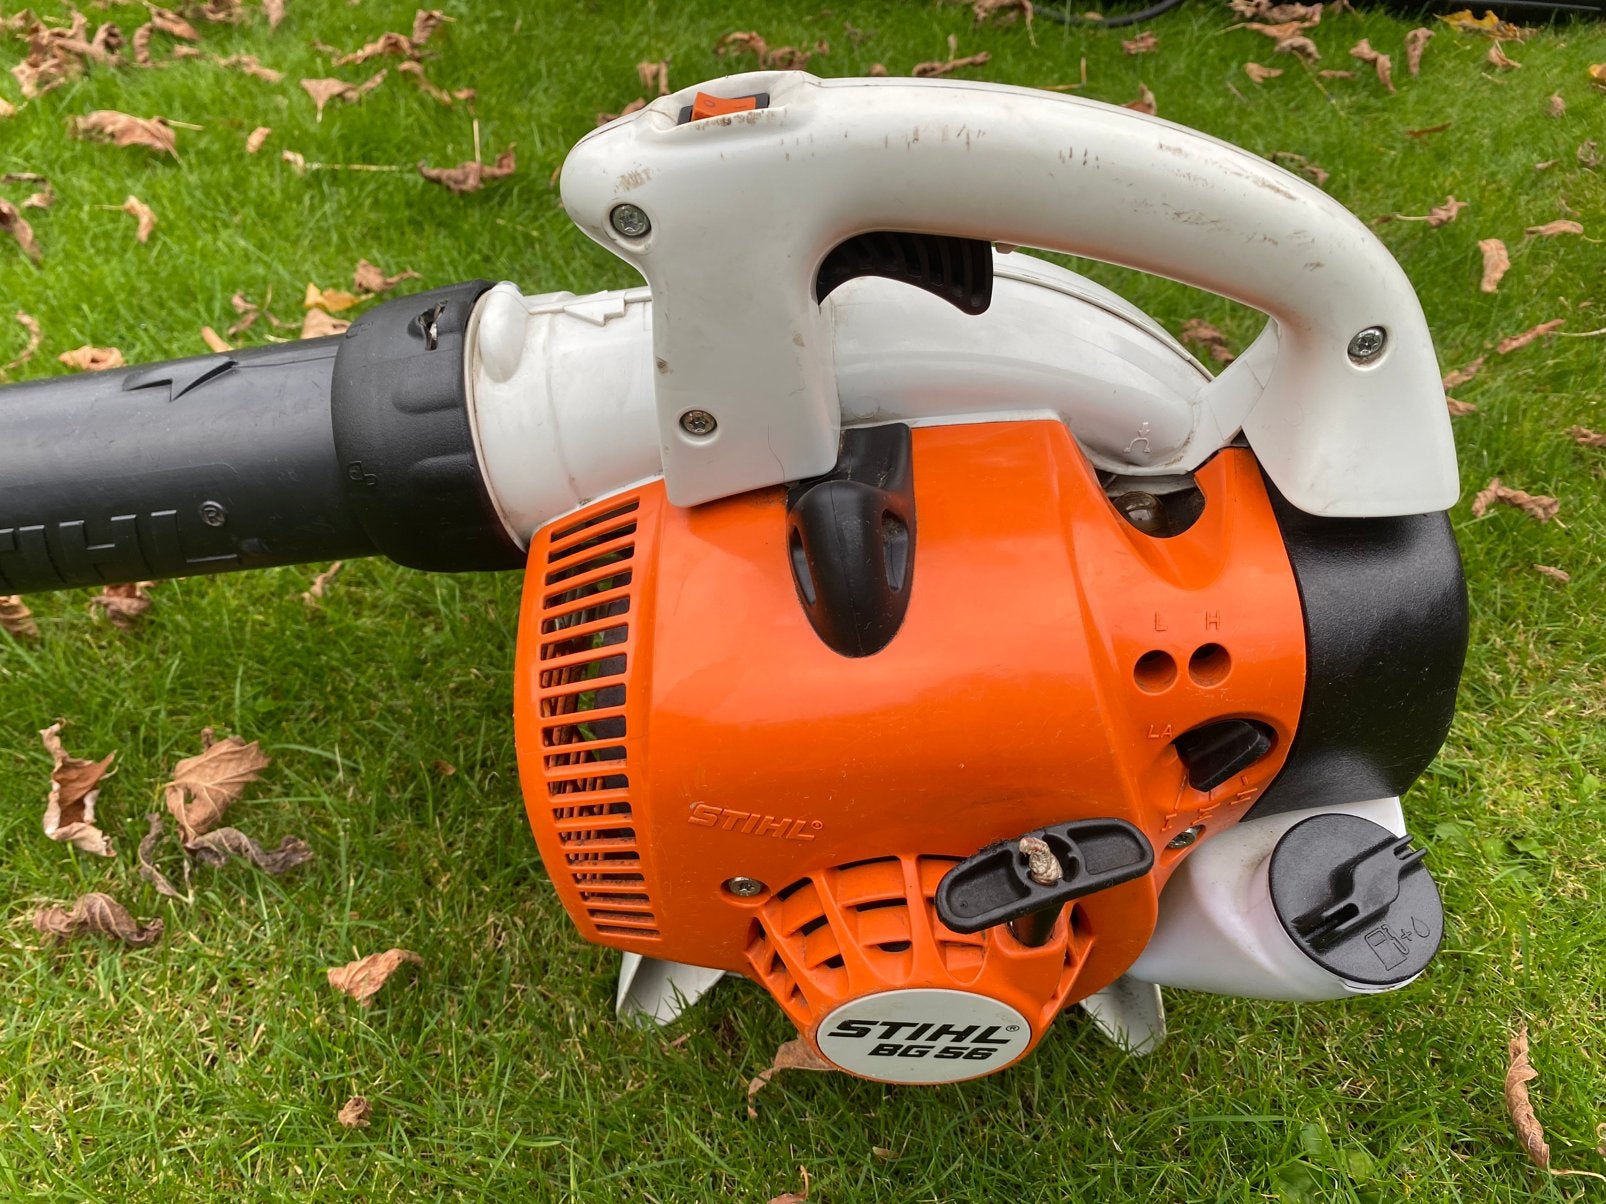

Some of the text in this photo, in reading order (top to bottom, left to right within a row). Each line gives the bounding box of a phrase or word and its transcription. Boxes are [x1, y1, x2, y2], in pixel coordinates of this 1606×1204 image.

[1154, 612, 1168, 632] L
[1205, 610, 1221, 631] H
[1148, 724, 1174, 738] LA
[867, 1043, 999, 1060] BG 56
